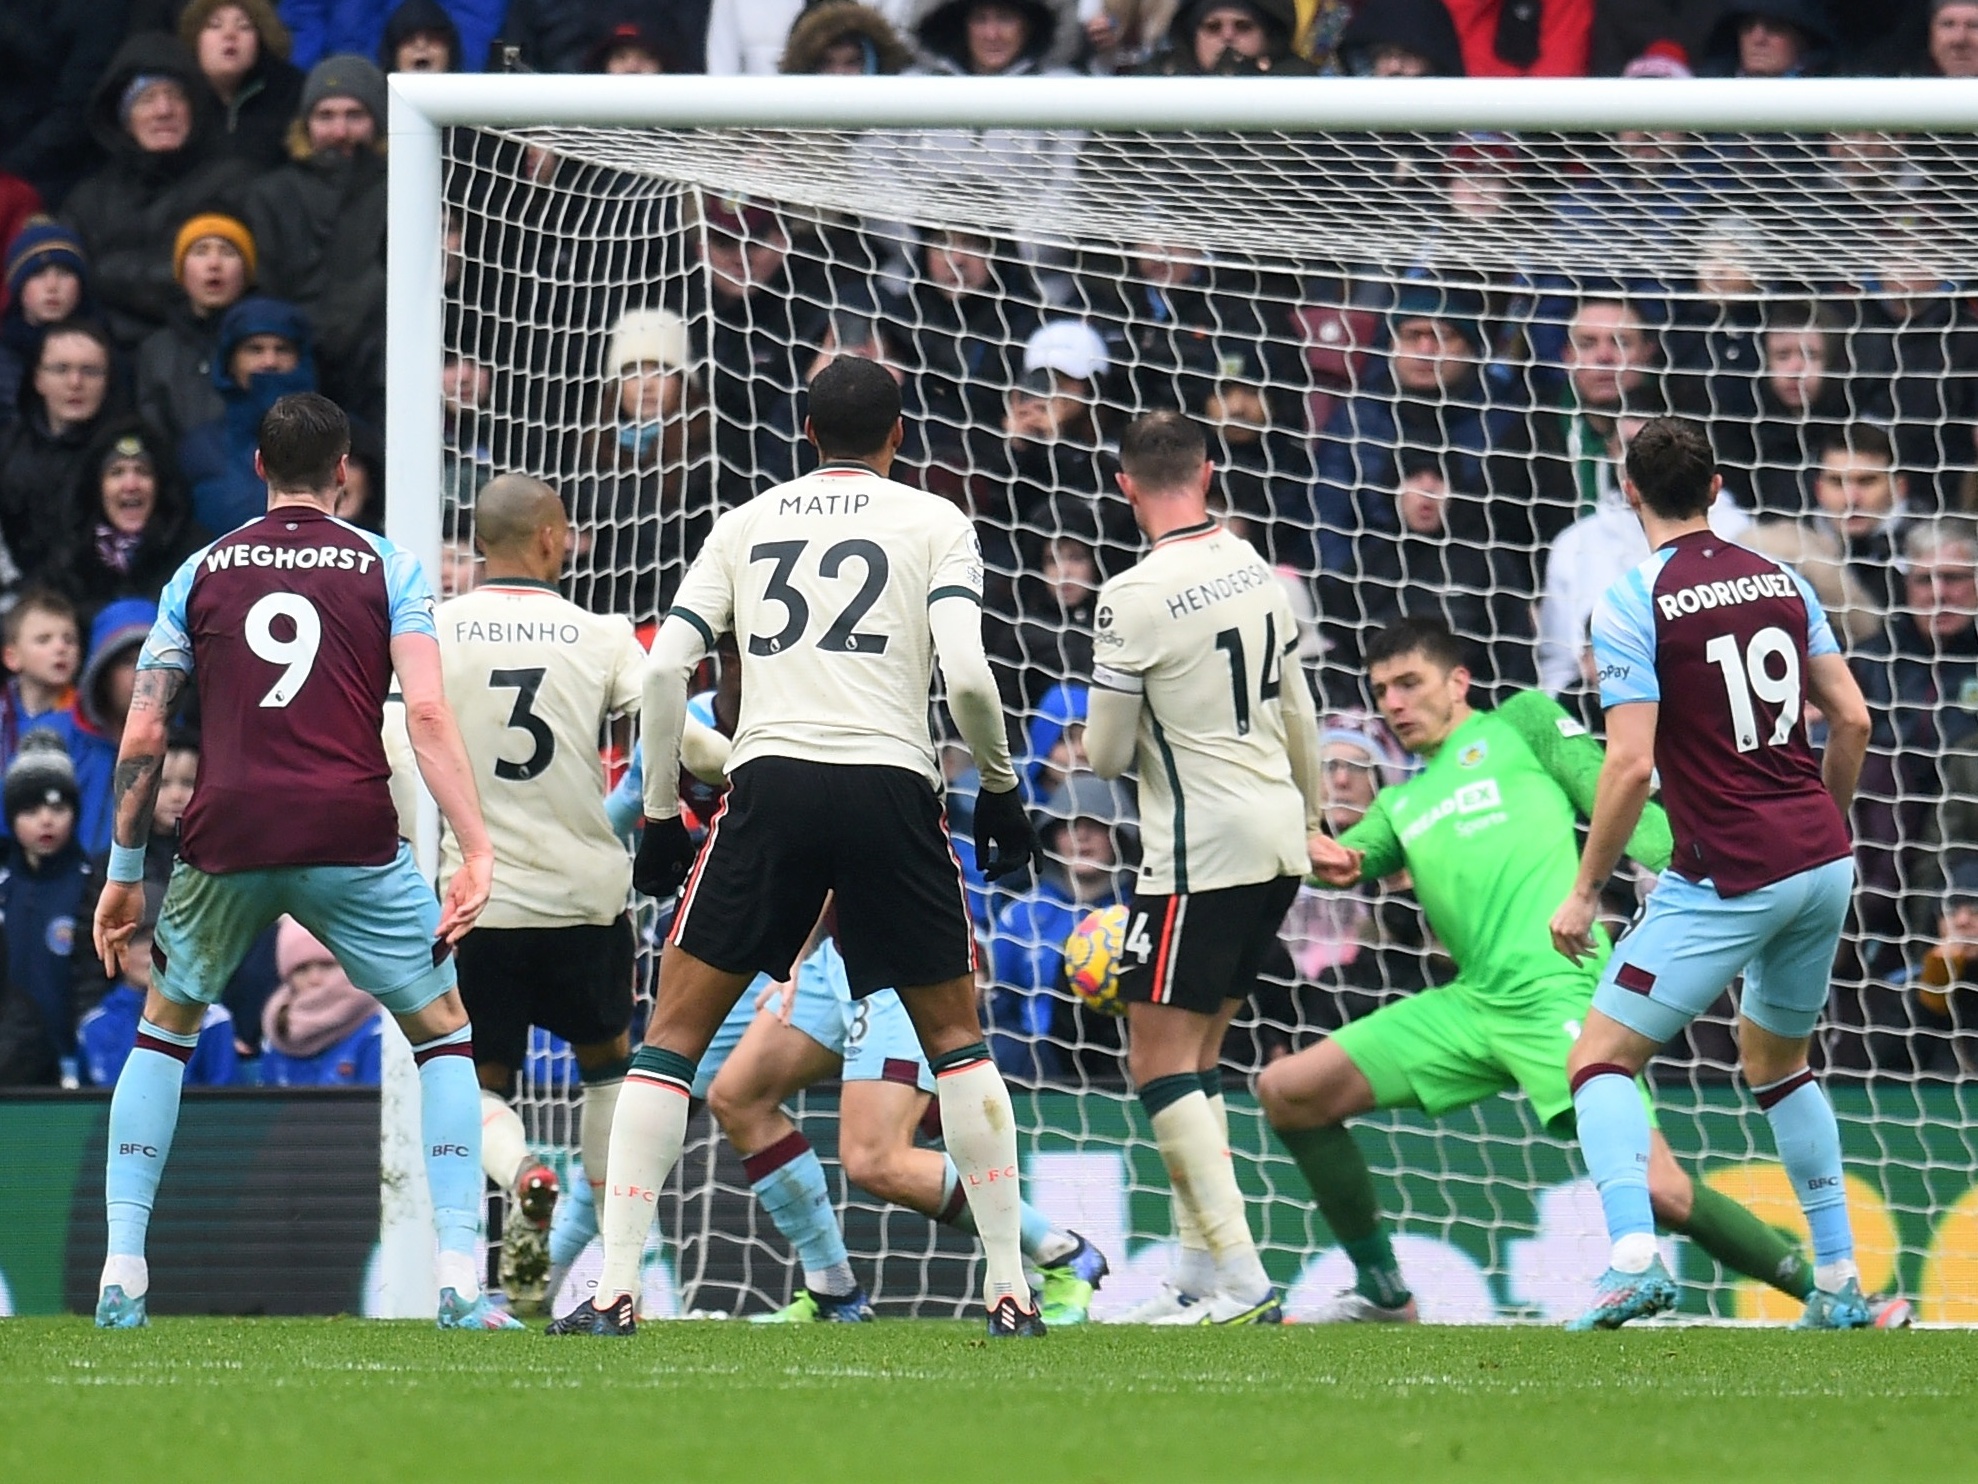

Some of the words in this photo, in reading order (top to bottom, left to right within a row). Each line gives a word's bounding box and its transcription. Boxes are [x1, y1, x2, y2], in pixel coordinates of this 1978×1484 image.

[779, 493, 870, 515] MATIP
[206, 544, 376, 575] WEGHORST
[748, 538, 889, 656] 32
[1657, 573, 1798, 621] RODRIGUEZ
[456, 621, 579, 644] FABINHO
[244, 591, 321, 708] 9
[1706, 626, 1800, 753] 19
[489, 667, 555, 781] 3
[119, 1143, 158, 1158] BFC
[432, 1144, 469, 1158] BFC
[1808, 1175, 1839, 1190] BFC
